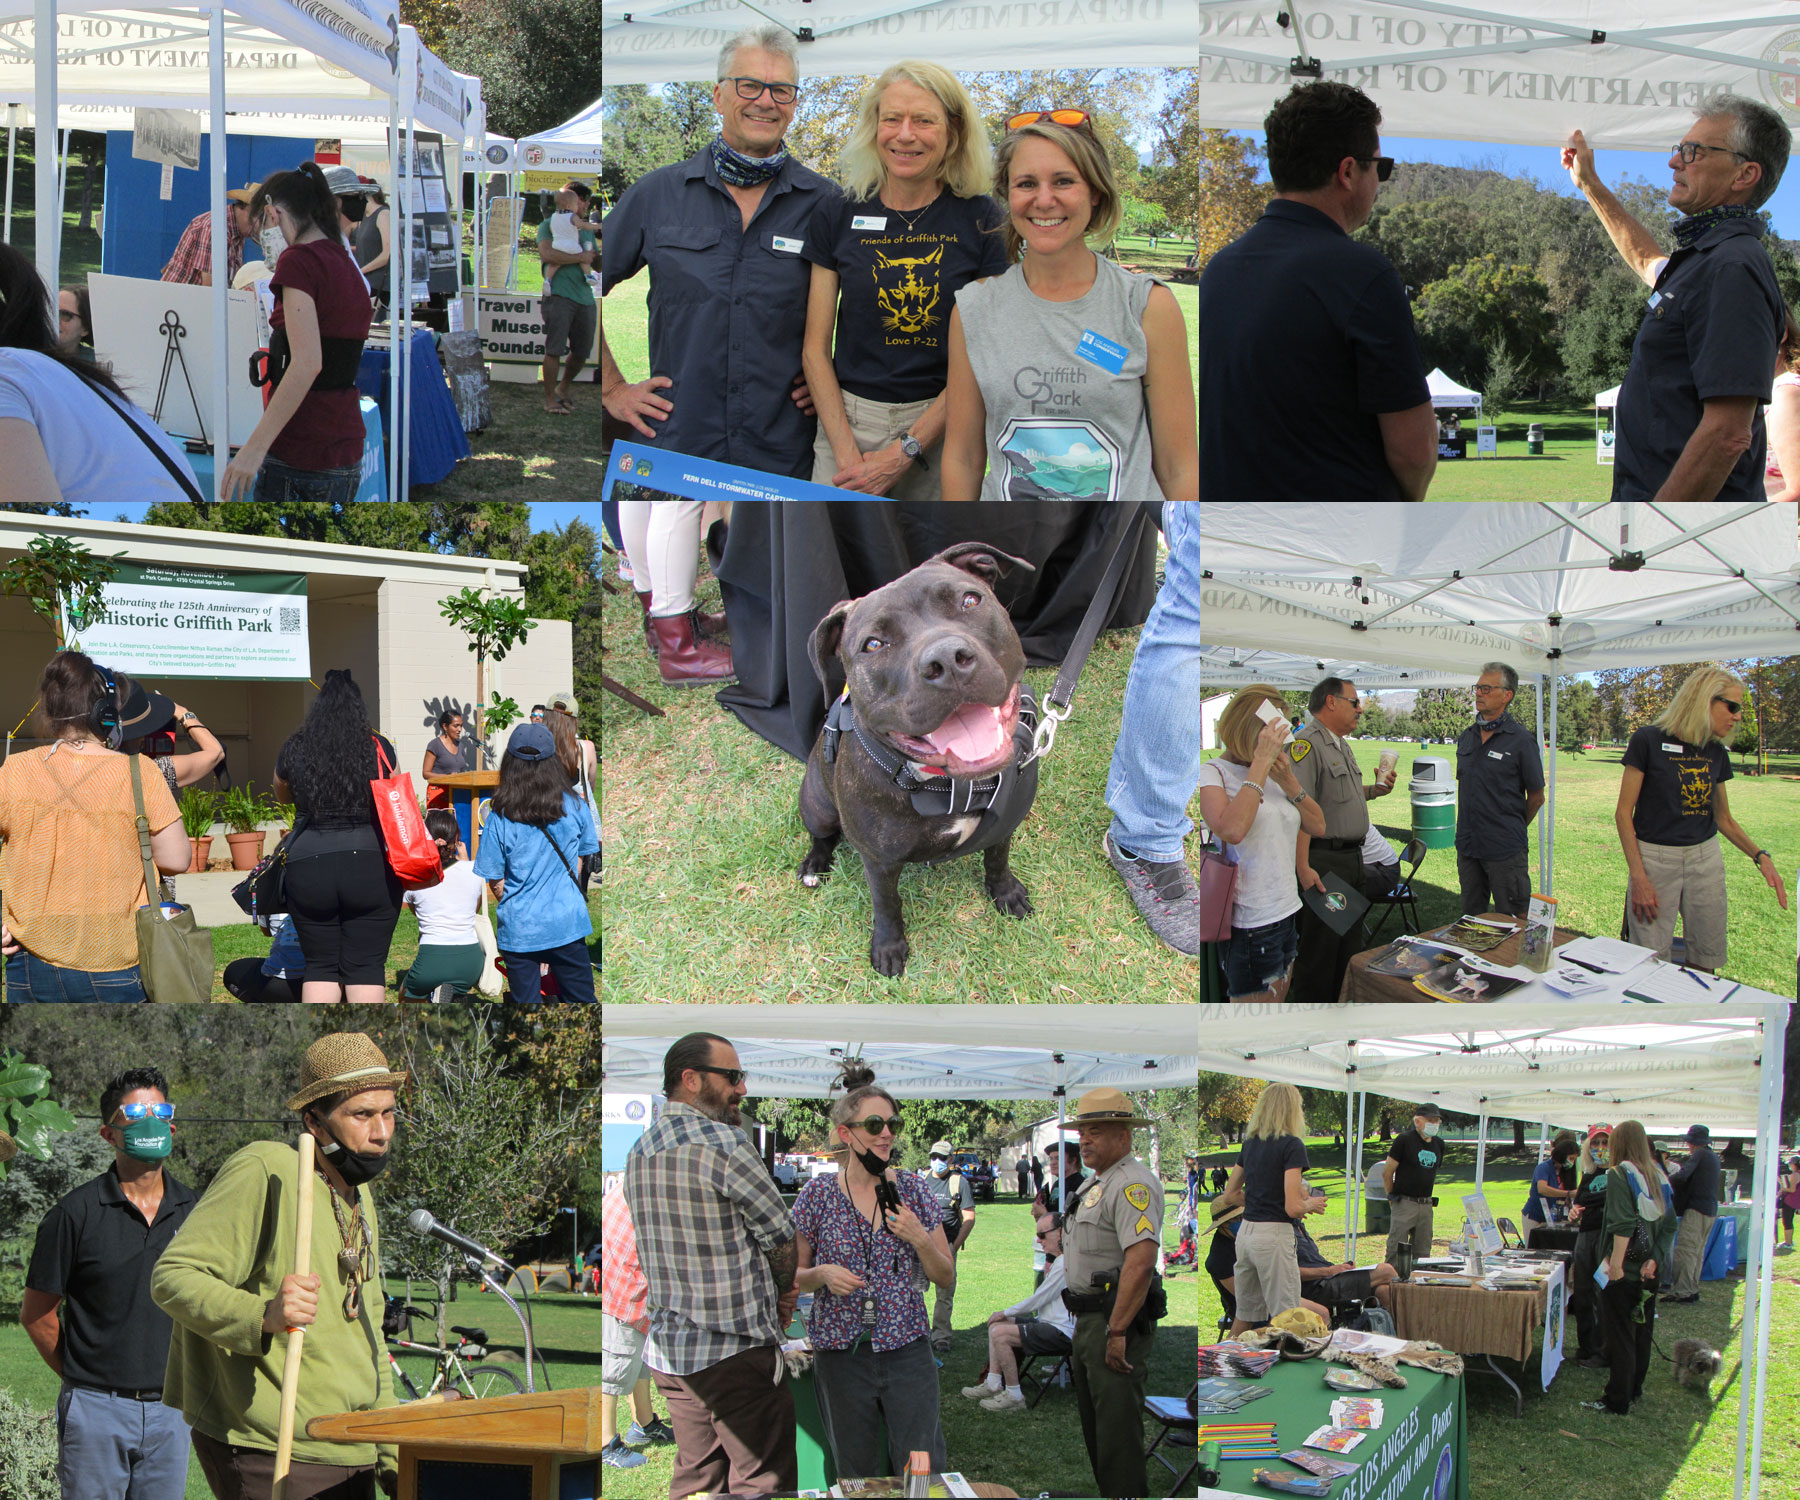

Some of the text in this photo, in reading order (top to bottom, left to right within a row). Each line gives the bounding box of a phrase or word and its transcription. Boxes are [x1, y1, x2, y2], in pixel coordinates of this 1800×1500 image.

[861, 233, 958, 245] Friends of Griffith Park
[474, 298, 531, 313] Travel
[885, 336, 938, 347] Love P-22
[1014, 366, 1087, 399] Griffith
[1031, 381, 1081, 415] Park
[682, 473, 700, 484] FERN
[700, 477, 716, 488] DELL
[718, 481, 764, 499] STORMWATER
[146, 566, 180, 578] Saturday,
[181, 569, 215, 579] November
[100, 596, 273, 616] Celebrating the 125th Anniversary of
[100, 611, 273, 633] Historic Griffith Park
[119, 643, 151, 651] Conservancy,
[145, 652, 159, 660] many
[173, 653, 205, 661] organizations
[392, 802, 409, 845] lululemon
[1359, 1457, 1379, 1500] LOS
[1380, 1405, 1420, 1477] ANGELES
[1413, 1438, 1430, 1476] AND
